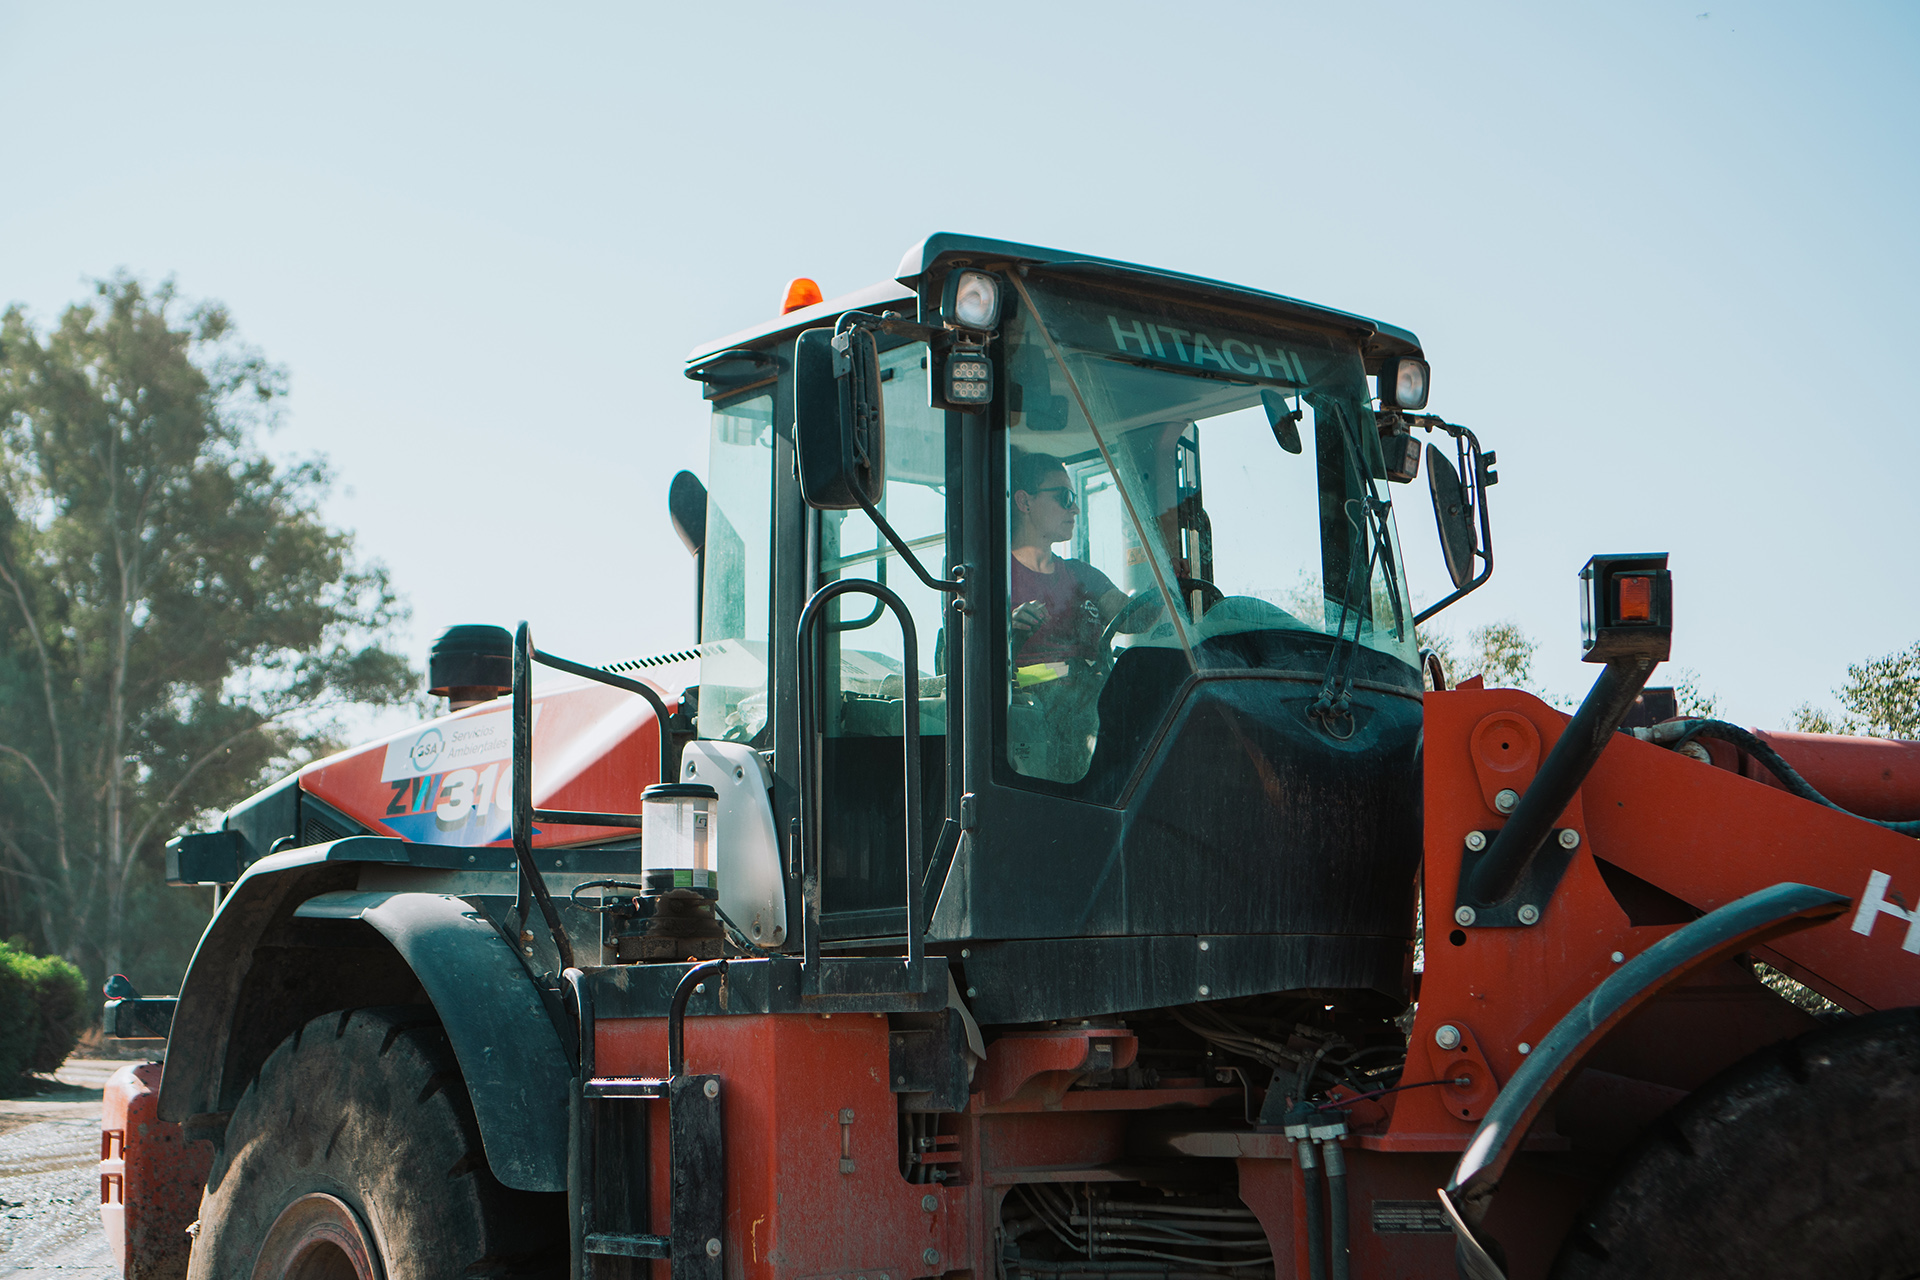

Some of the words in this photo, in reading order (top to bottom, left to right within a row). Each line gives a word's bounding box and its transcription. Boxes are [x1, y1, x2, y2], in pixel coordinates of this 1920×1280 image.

[1107, 315, 1309, 385] HITACHI
[448, 738, 508, 758] Ambientales
[452, 726, 495, 743] Servicios
[1851, 869, 1920, 955] H
